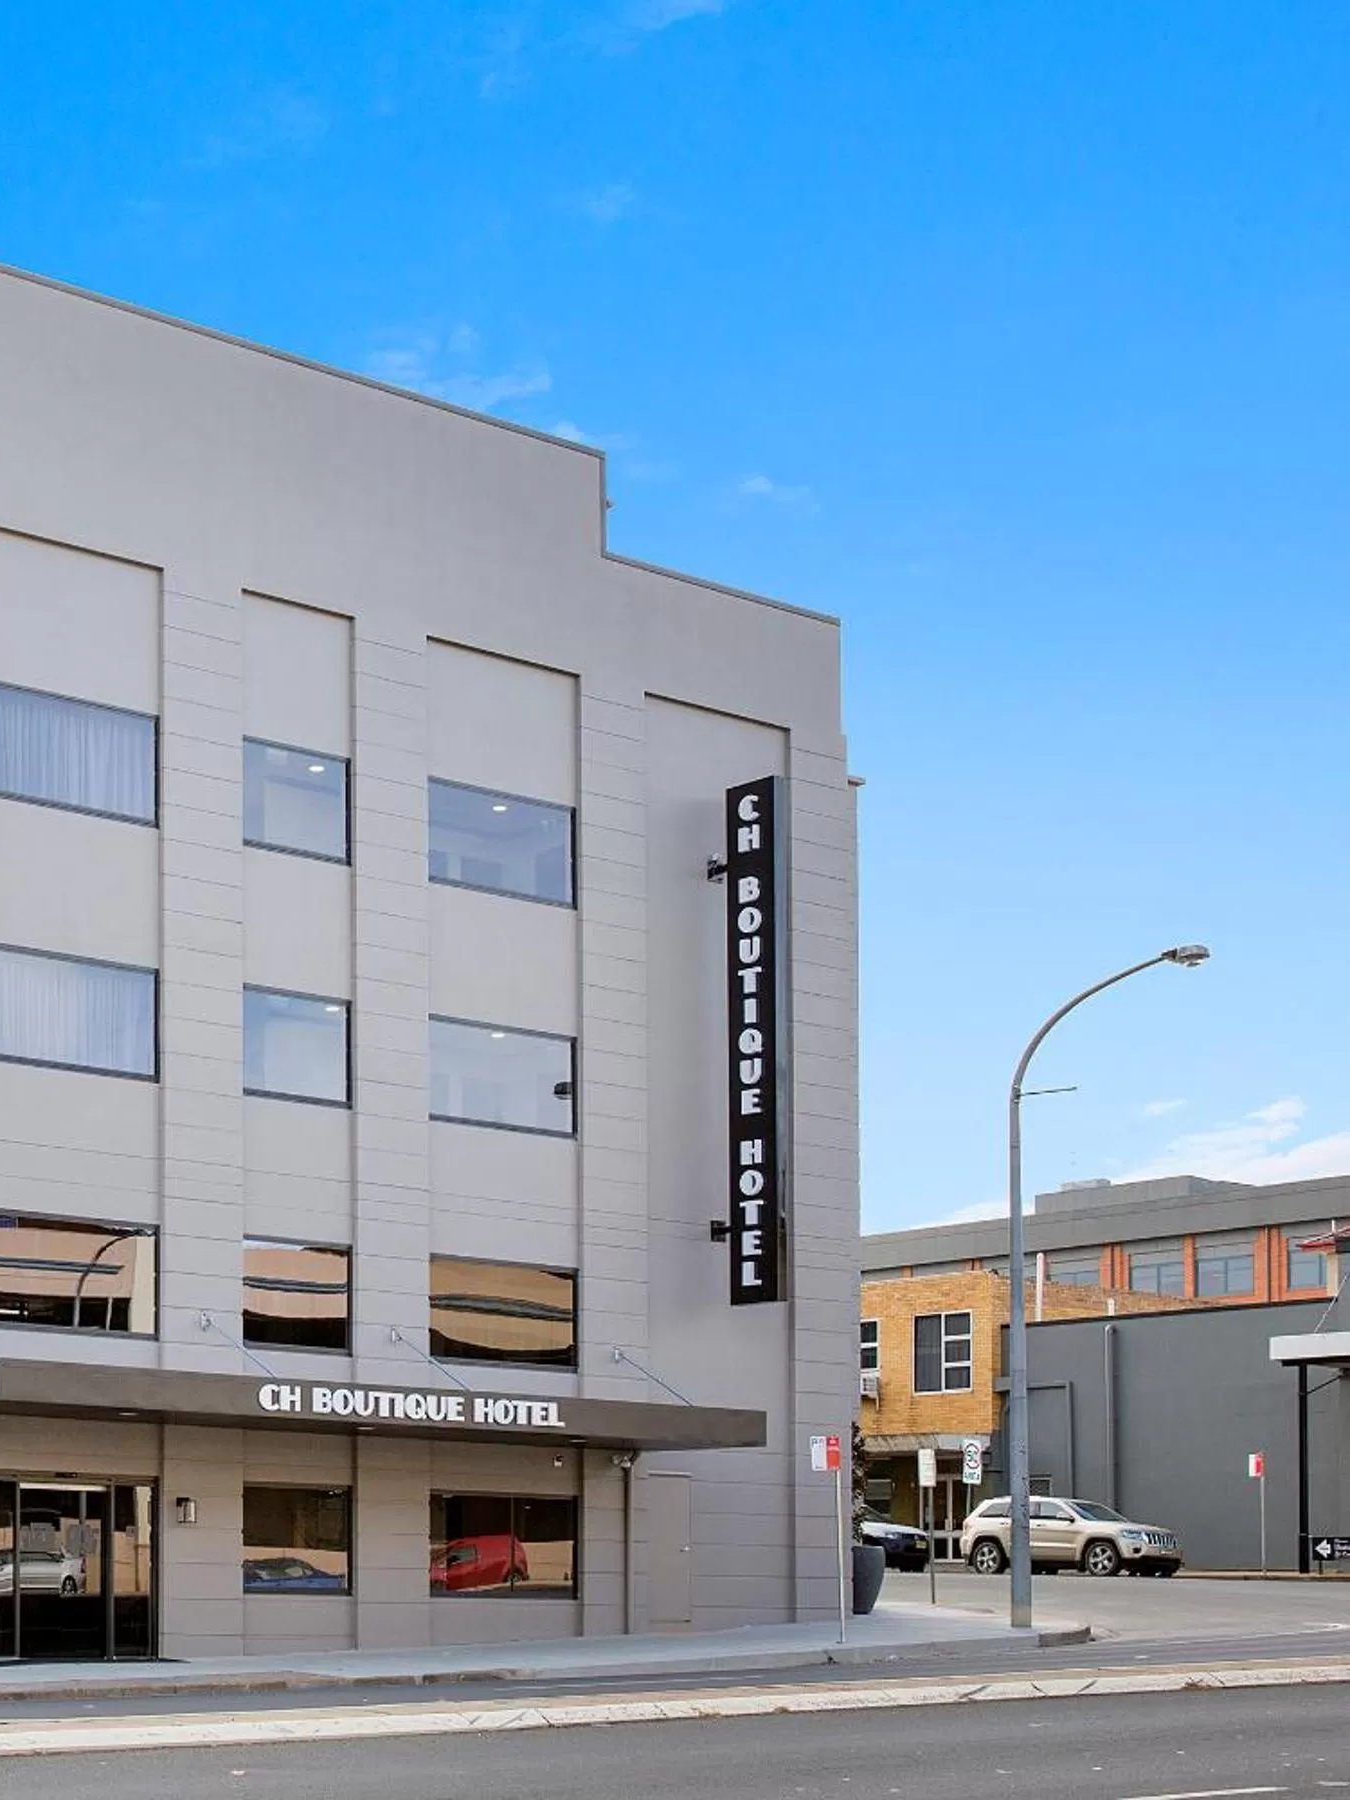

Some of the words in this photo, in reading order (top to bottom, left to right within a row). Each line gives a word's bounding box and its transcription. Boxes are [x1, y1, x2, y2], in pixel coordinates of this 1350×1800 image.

[736, 794, 761, 853] CH
[737, 875, 763, 1116] BOUTIQUE
[738, 1138, 764, 1287] HOTEL
[258, 1383, 302, 1412] CH
[312, 1386, 466, 1422] BOUTIQUE
[473, 1398, 566, 1427] HOTEL
